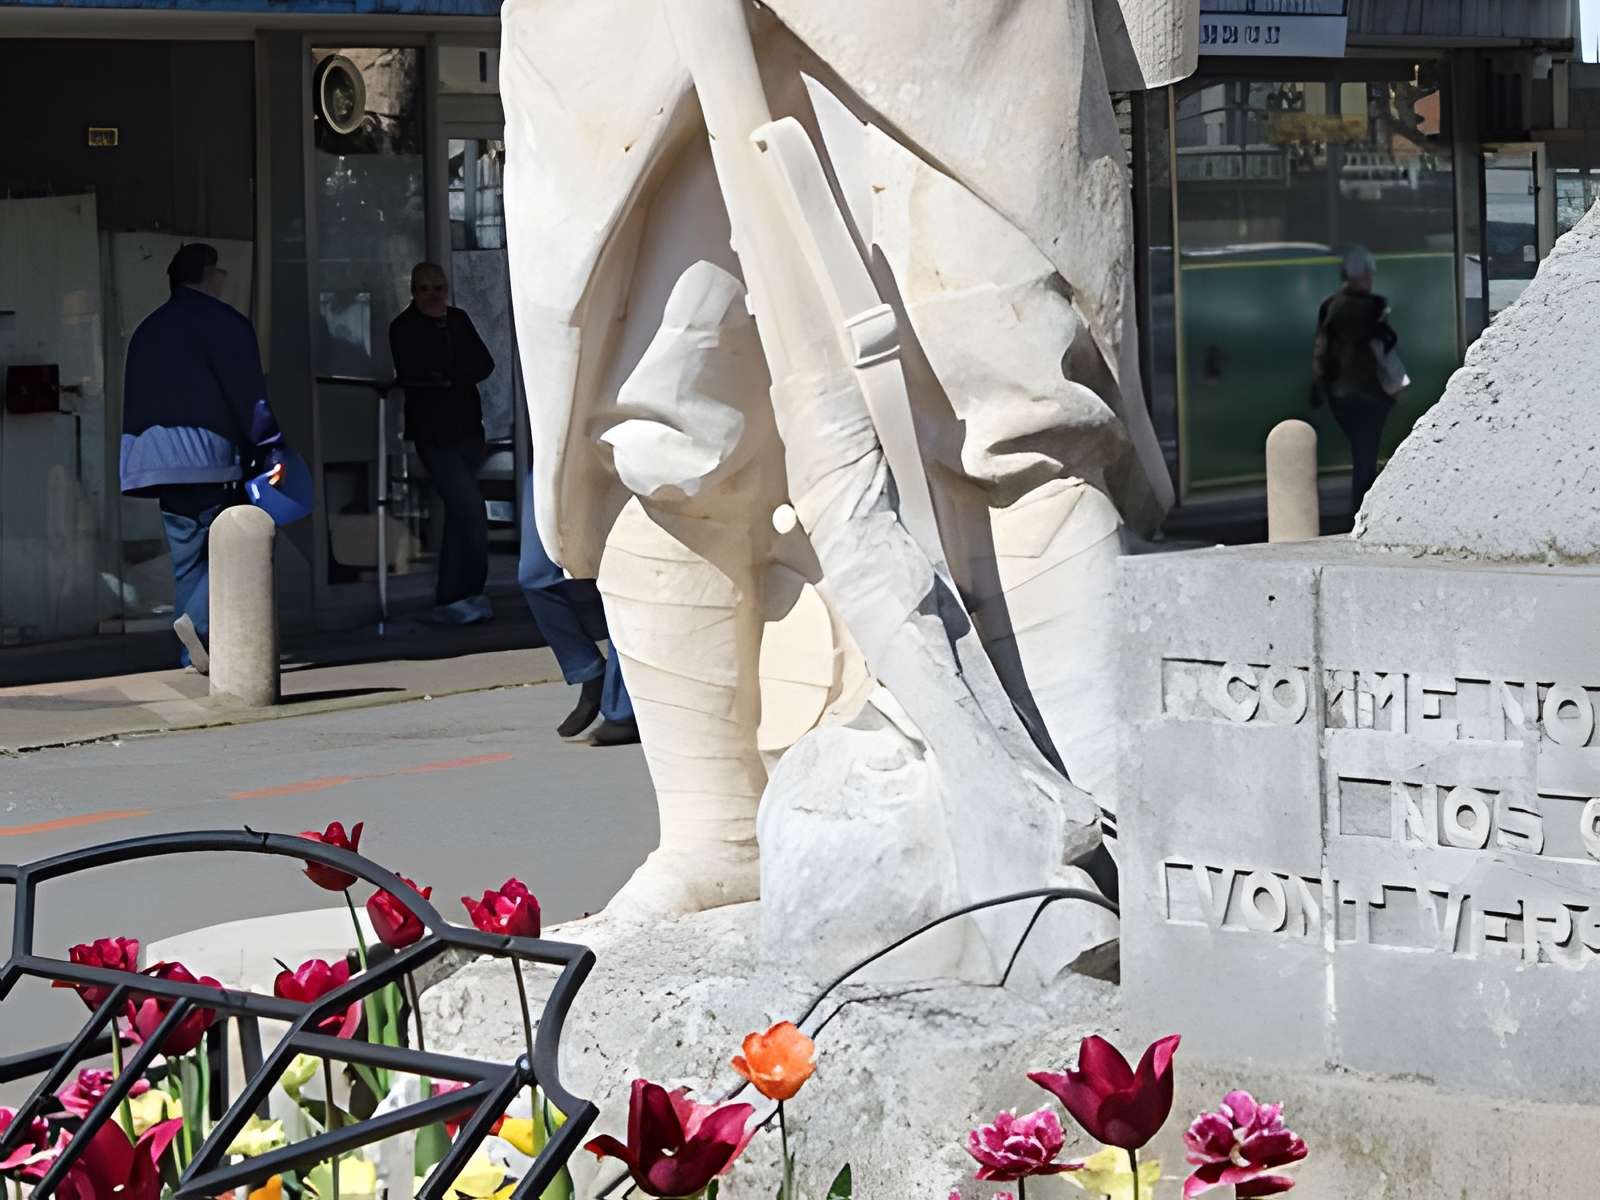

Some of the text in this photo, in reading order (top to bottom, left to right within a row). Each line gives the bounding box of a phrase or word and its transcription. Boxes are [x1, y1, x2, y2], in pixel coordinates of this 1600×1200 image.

[1217, 660, 1459, 741] COMME
[1391, 777, 1545, 856] NOS
[1191, 860, 1385, 946] VONT
